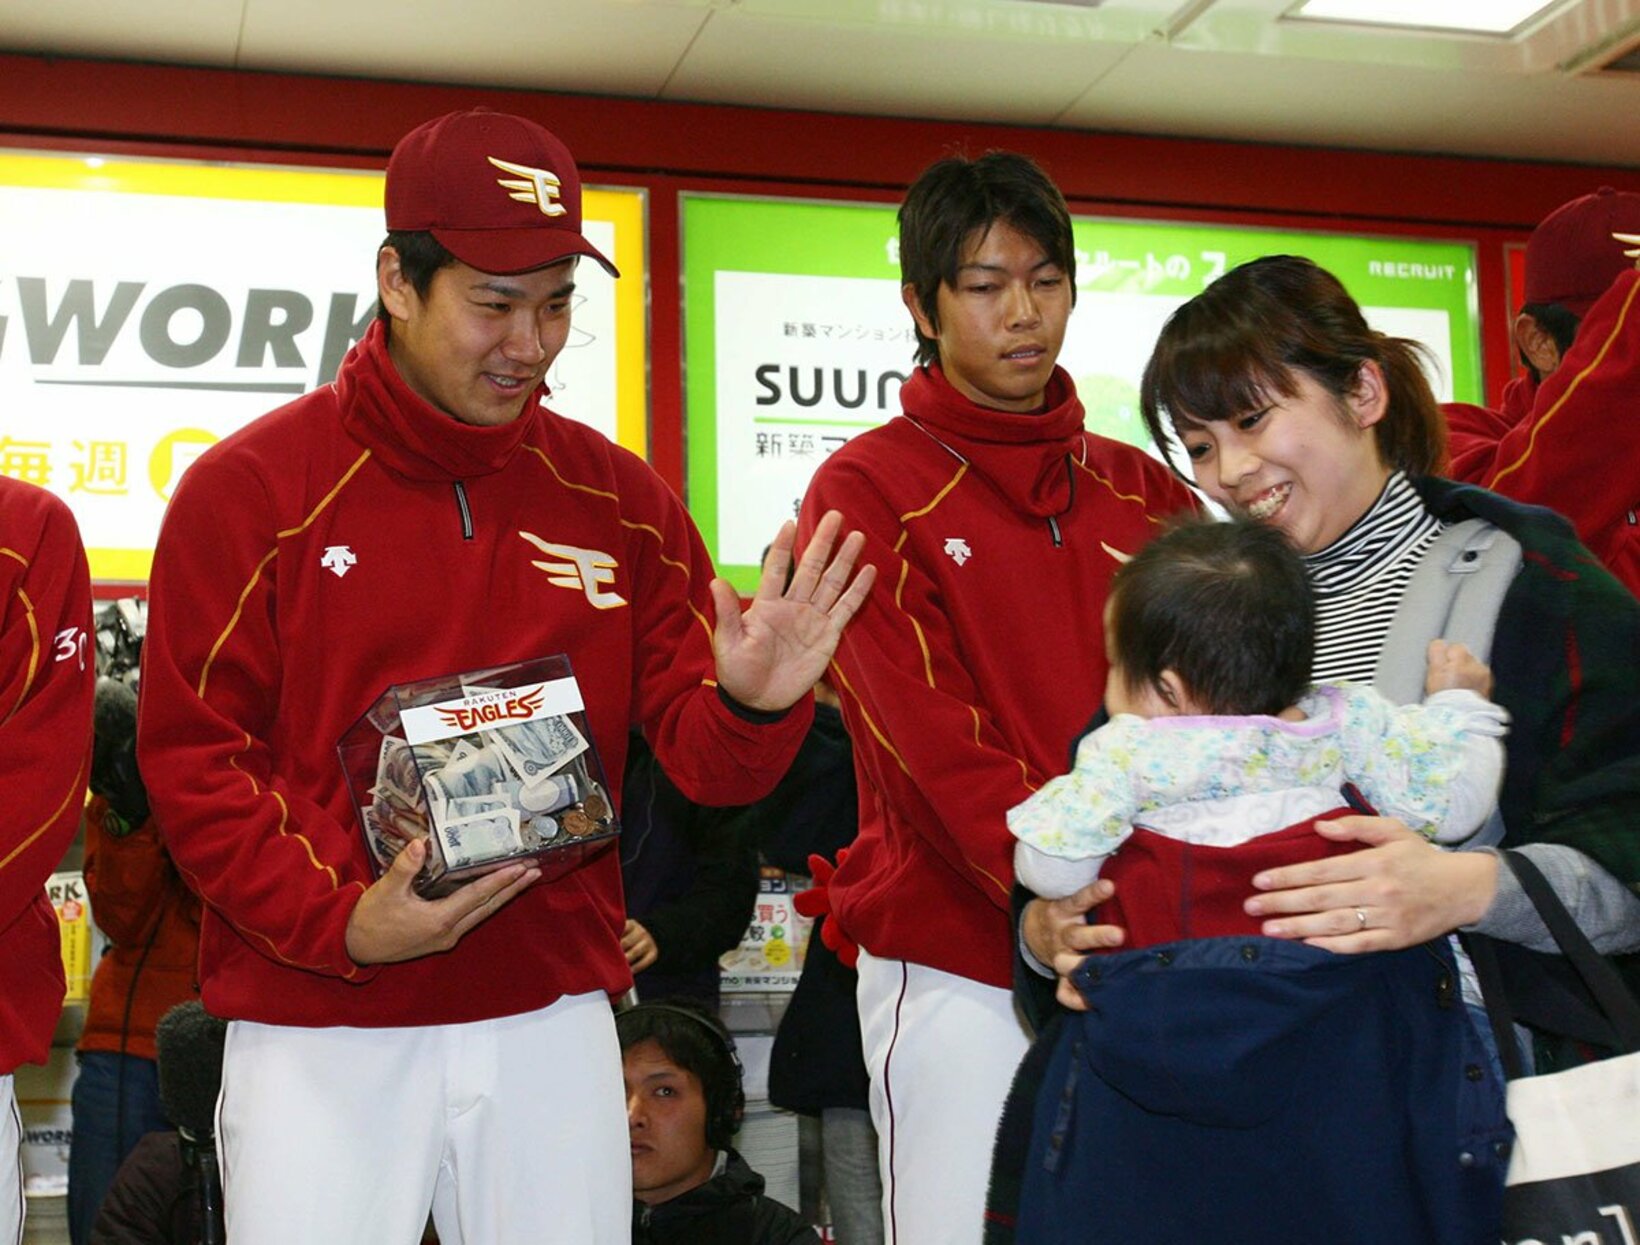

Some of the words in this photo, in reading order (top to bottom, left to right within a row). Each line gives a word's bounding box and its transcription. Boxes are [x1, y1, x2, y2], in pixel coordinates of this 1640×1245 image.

[1369, 260, 1455, 281] RECRUIT
[0, 276, 378, 388] WORK
[433, 685, 544, 731] EAGLES
[463, 690, 517, 706] RAKUTEN
[21, 1130, 72, 1145] WOR
